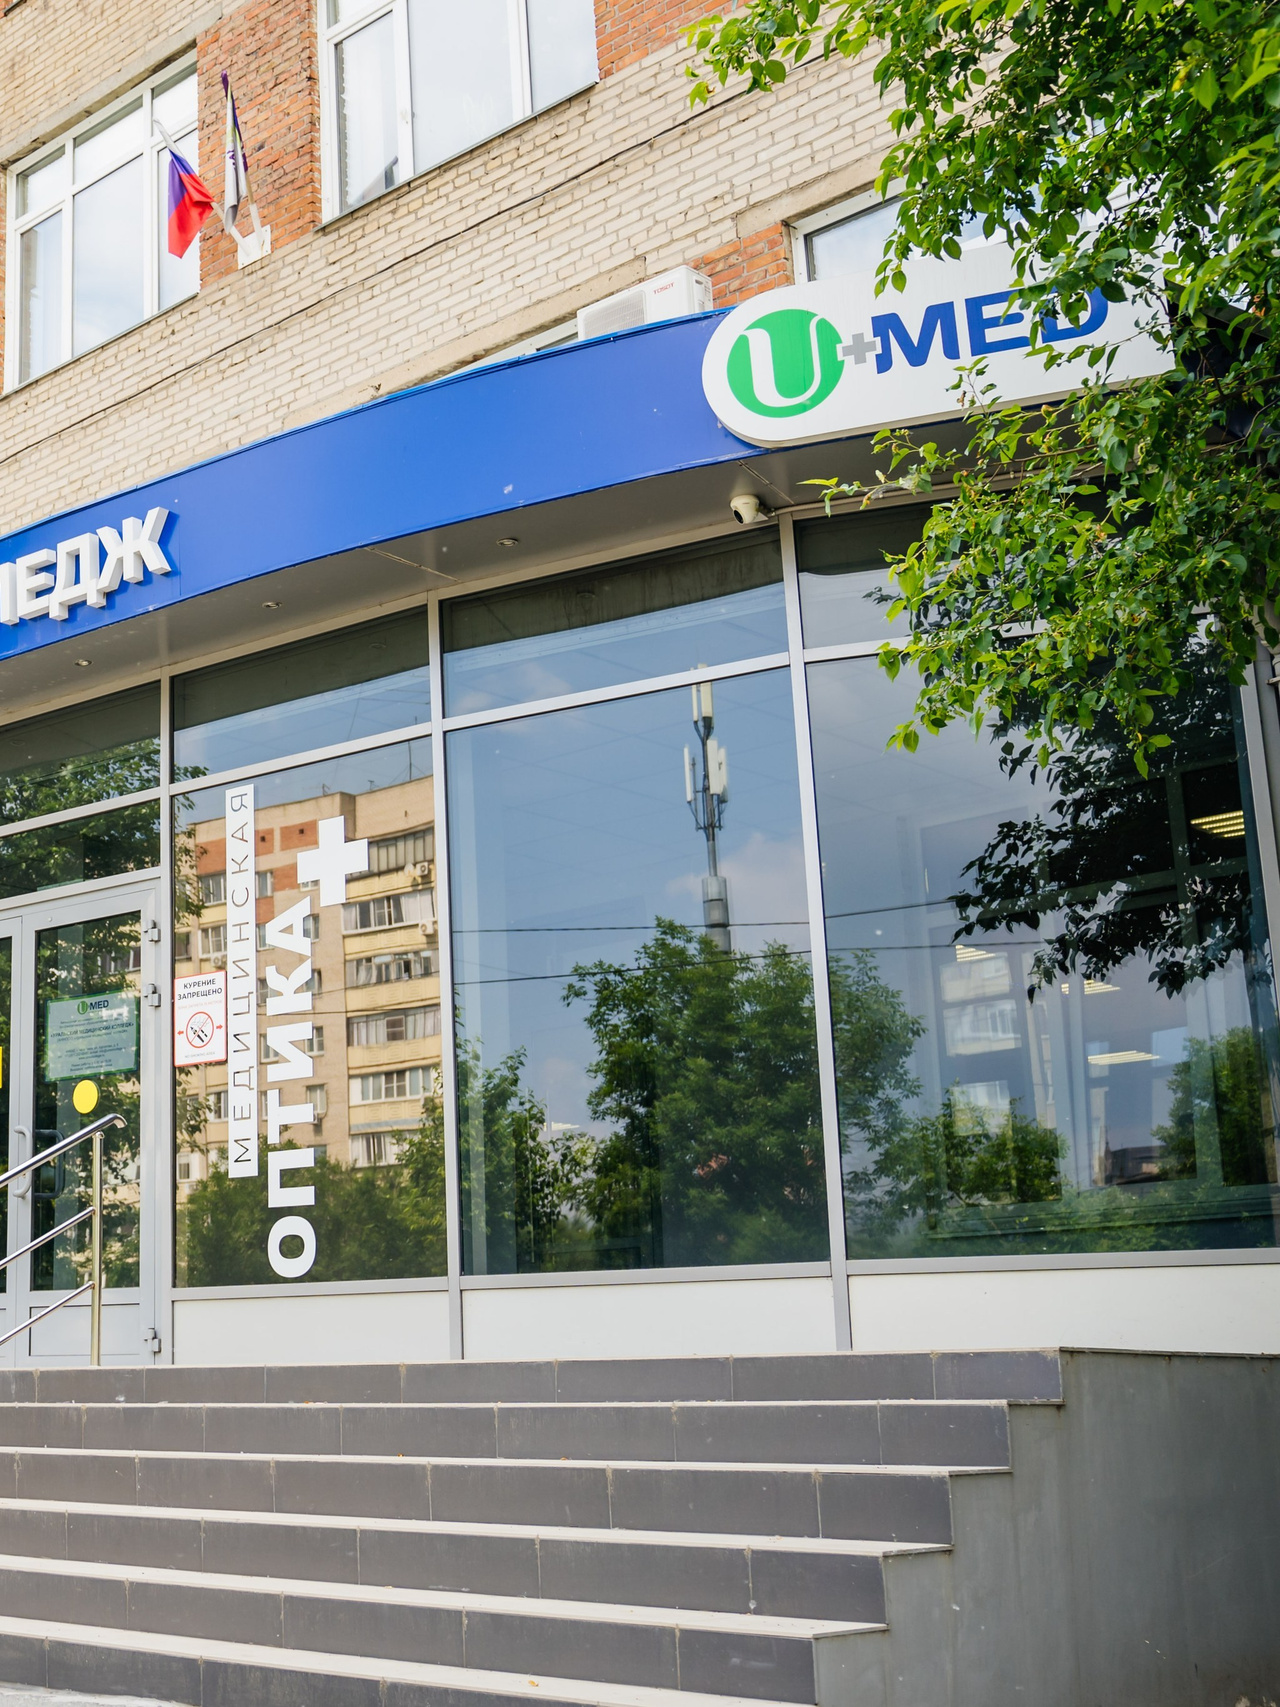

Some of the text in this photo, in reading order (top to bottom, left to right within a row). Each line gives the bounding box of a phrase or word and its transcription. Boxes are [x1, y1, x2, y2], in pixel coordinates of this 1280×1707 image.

[177, 987, 223, 1001] ЗАПРЕЩЕНО
[183, 978, 216, 990] КУРЕНИЕ
[230, 790, 255, 1164] МЕДИЦИНСКАЯ
[265, 895, 317, 1279] ОПТИКА
